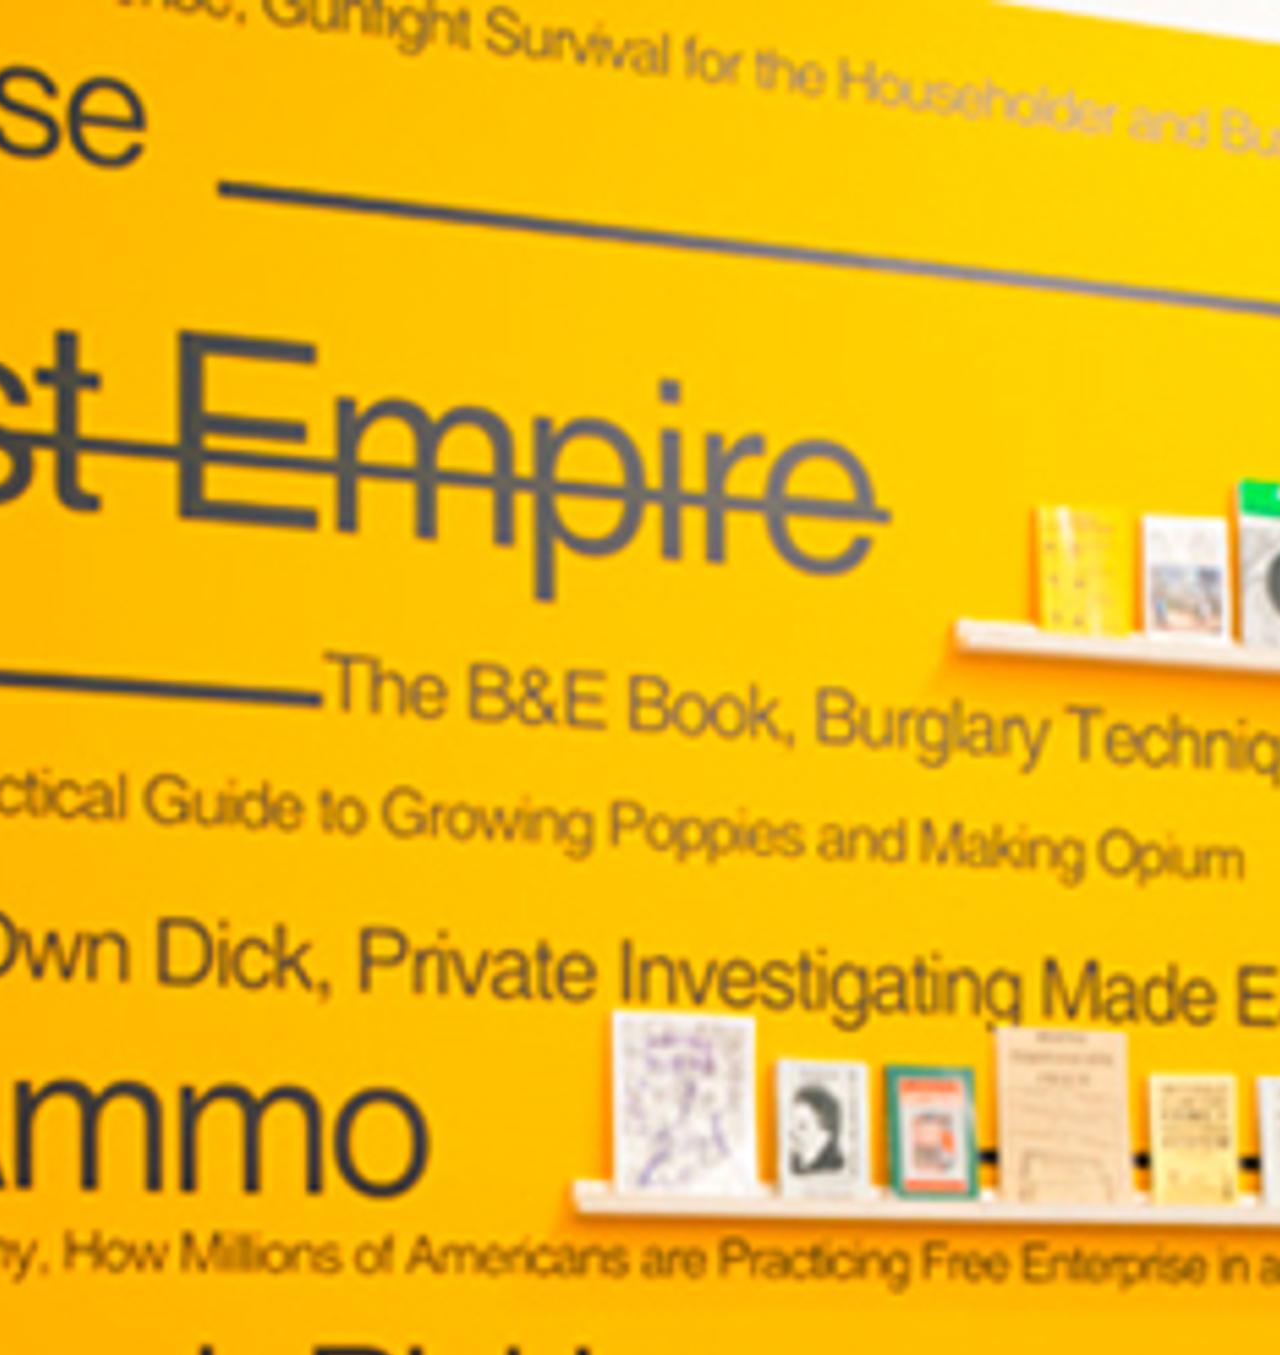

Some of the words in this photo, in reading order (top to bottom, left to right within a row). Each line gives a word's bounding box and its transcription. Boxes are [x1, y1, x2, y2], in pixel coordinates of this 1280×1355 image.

[486, 5, 670, 74] Survival
[684, 37, 740, 79] for
[753, 42, 827, 99] the
[837, 55, 1117, 137] Householder
[1127, 100, 1210, 149] and
[177, 328, 892, 600] Empire
[322, 650, 448, 722] The
[468, 662, 605, 731] B&E
[628, 674, 795, 745] Book,
[815, 686, 1051, 774] Burglary
[142, 773, 305, 832] Guide
[319, 790, 367, 835] to
[381, 785, 594, 857] Growing
[610, 800, 806, 861] Poppies
[817, 823, 906, 862] and
[921, 818, 1086, 884] Making
[1097, 828, 1244, 882] Opium
[156, 915, 331, 997] Dick,
[358, 925, 598, 1003] Private
[618, 936, 1022, 1032] Investigating
[1041, 956, 1218, 1027] Made
[63, 1232, 164, 1274] How
[180, 1230, 343, 1275] Millions
[355, 1232, 398, 1276] of
[405, 1234, 630, 1278] Americans
[640, 1247, 707, 1279] are
[718, 1235, 911, 1292] Practicing
[921, 1239, 1010, 1282] Free
[1021, 1240, 1208, 1287] Enterprise
[1220, 1254, 1250, 1282] in
